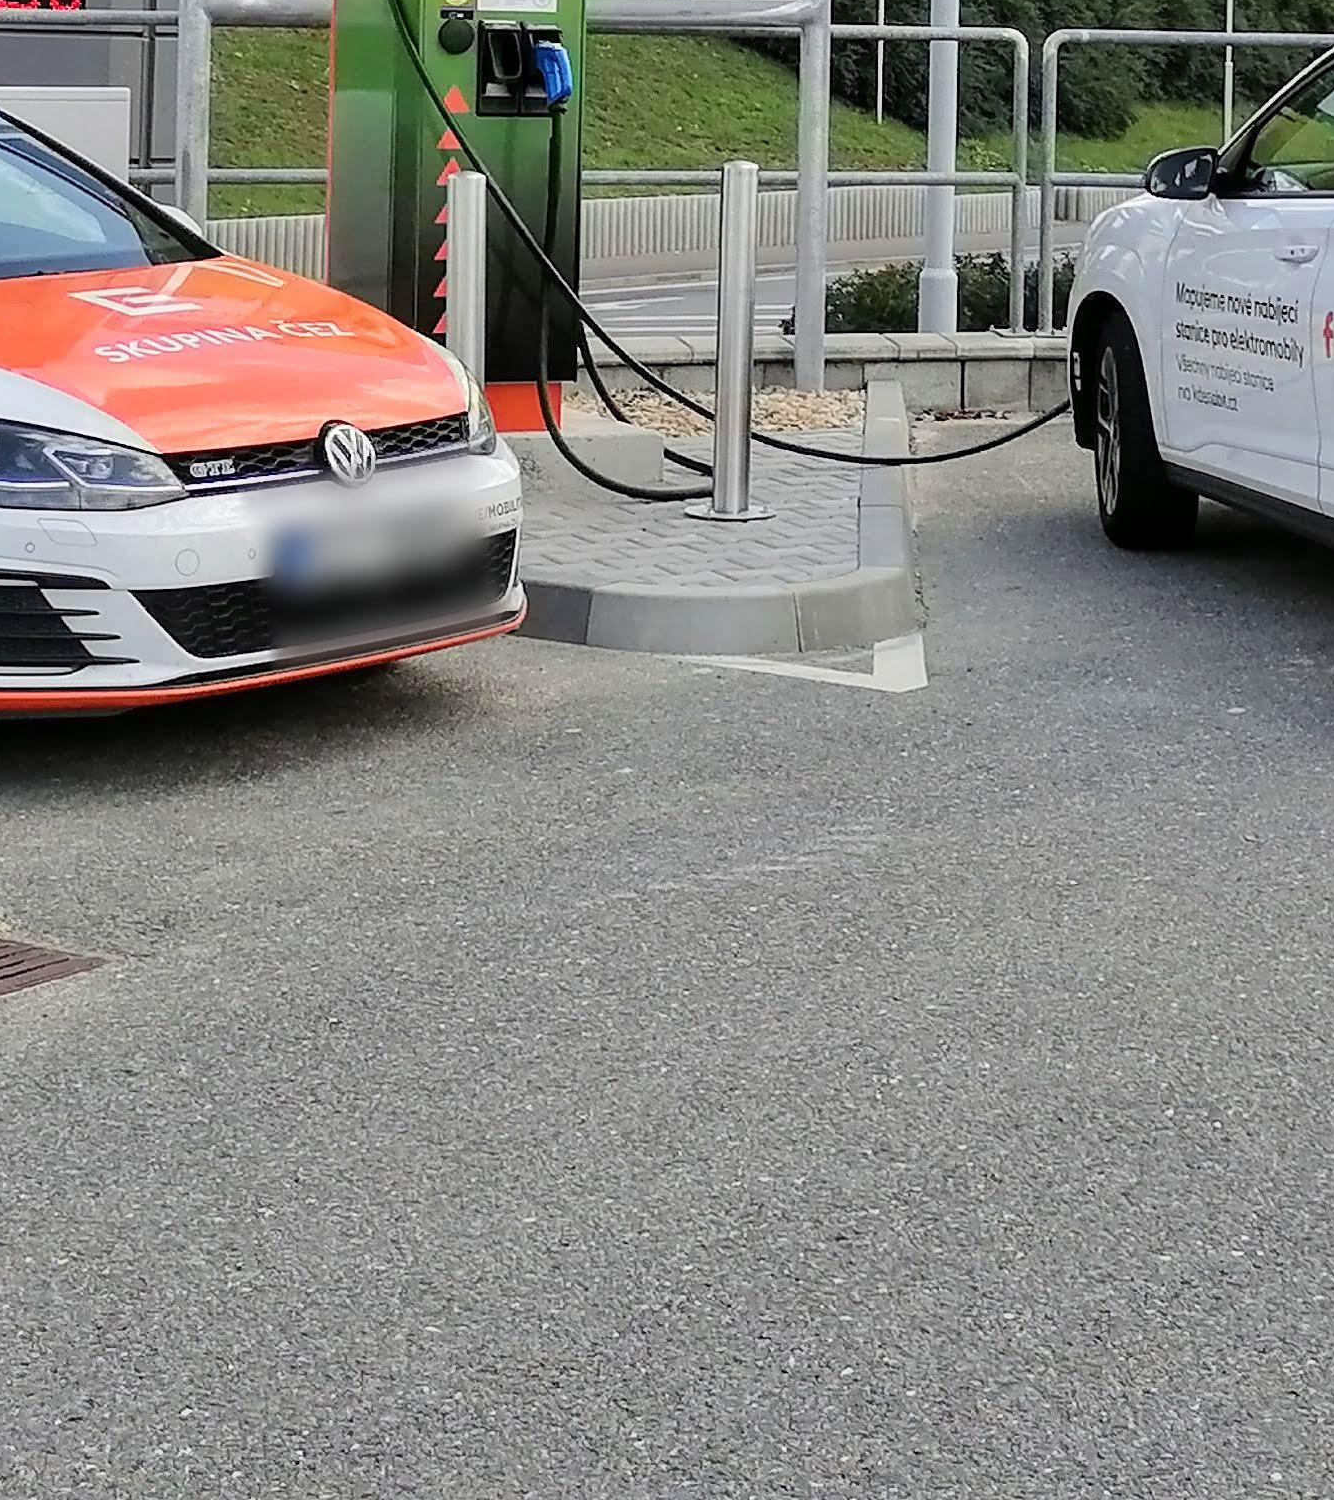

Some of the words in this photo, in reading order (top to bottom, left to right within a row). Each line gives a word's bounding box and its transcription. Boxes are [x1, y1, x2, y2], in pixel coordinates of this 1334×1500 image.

[1176, 282, 1225, 312] Mapujeme
[1227, 292, 1252, 316] nové
[94, 325, 283, 363] SKUPINA
[269, 319, 356, 338] ČEZ
[1176, 319, 1210, 343] stanice
[1212, 329, 1228, 350] pro
[190, 459, 237, 478] GTE
